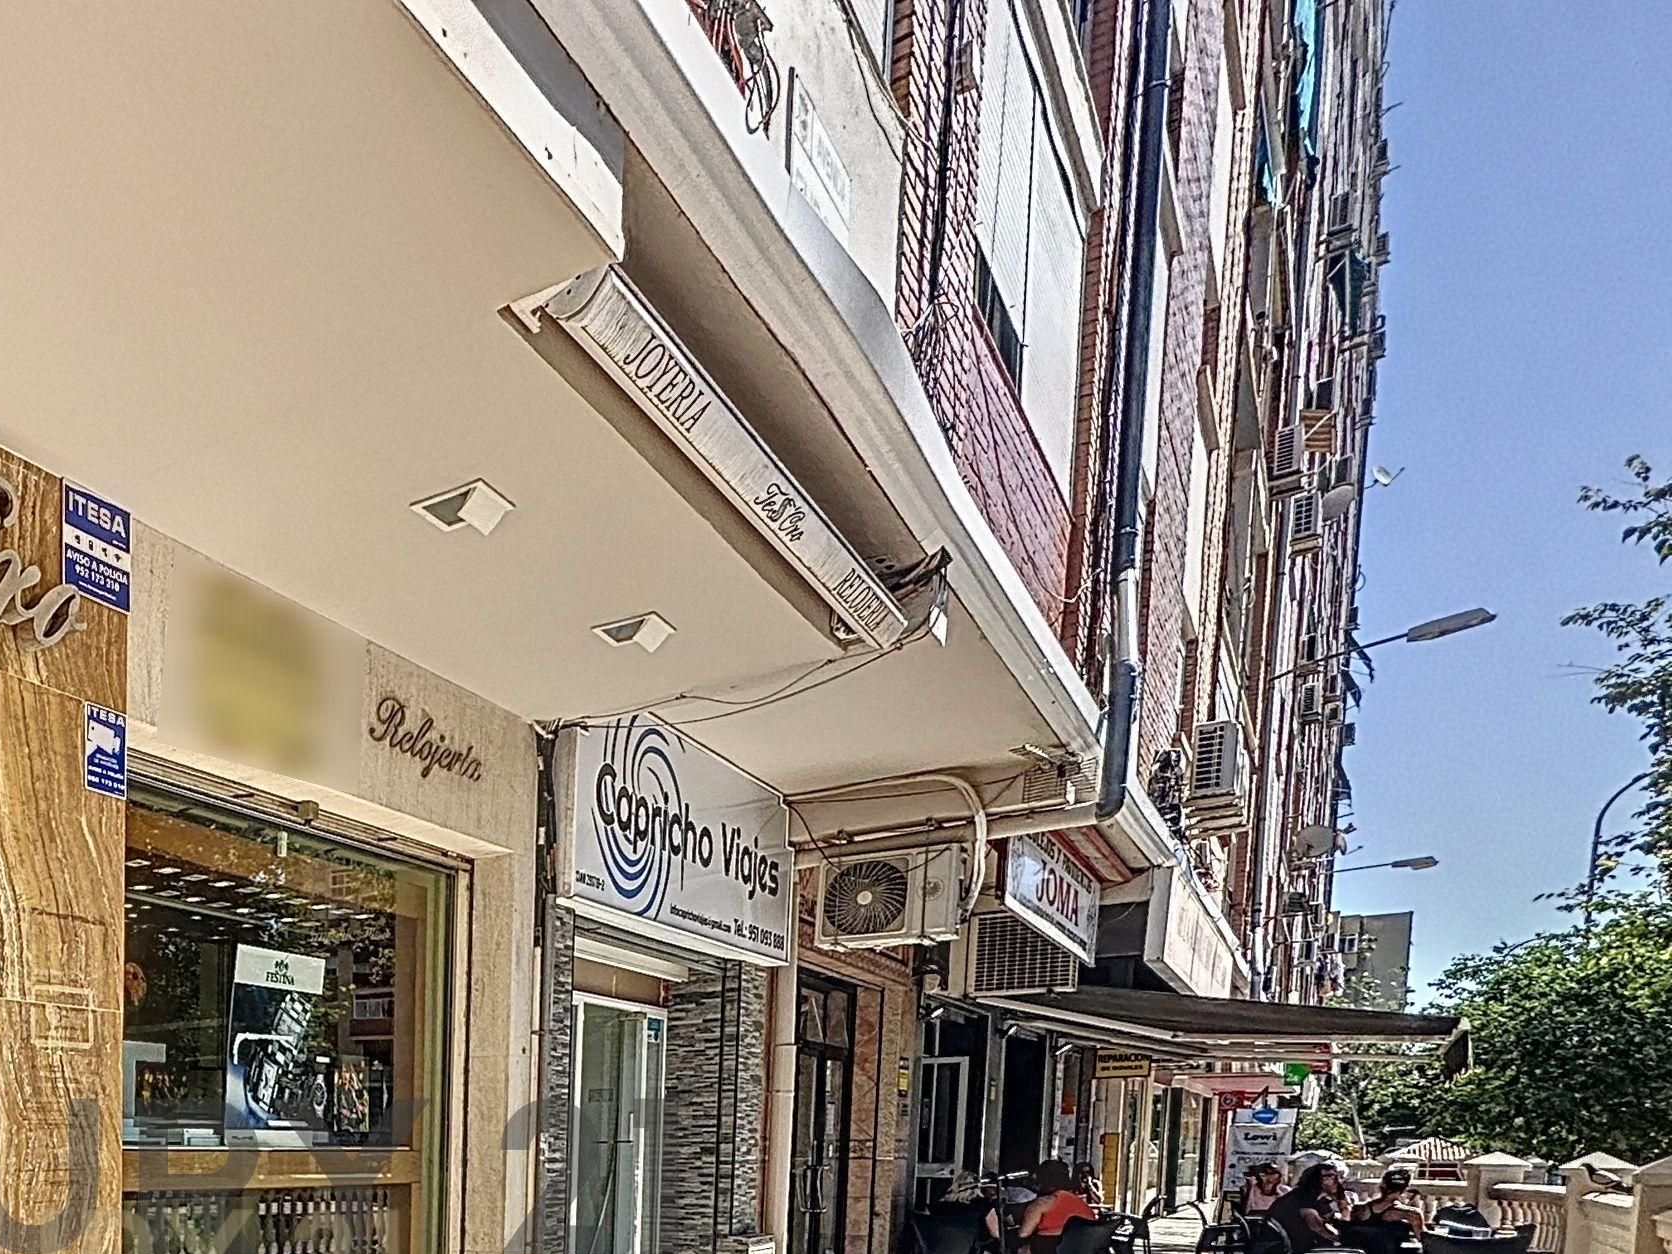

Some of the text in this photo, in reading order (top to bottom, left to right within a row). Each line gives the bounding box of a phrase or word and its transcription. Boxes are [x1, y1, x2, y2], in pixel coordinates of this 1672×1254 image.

[623, 332, 712, 433] JOYERIA
[68, 490, 126, 538] ITESA
[67, 548, 128, 585] AVISO A POLICIA
[88, 705, 125, 727] ITESA
[596, 762, 780, 901] Capricho Viajes
[1036, 859, 1079, 927] JOMA
[748, 924, 759, 942] 951
[265, 972, 295, 986] FESTINA
[1243, 1131, 1278, 1141] Lowi
